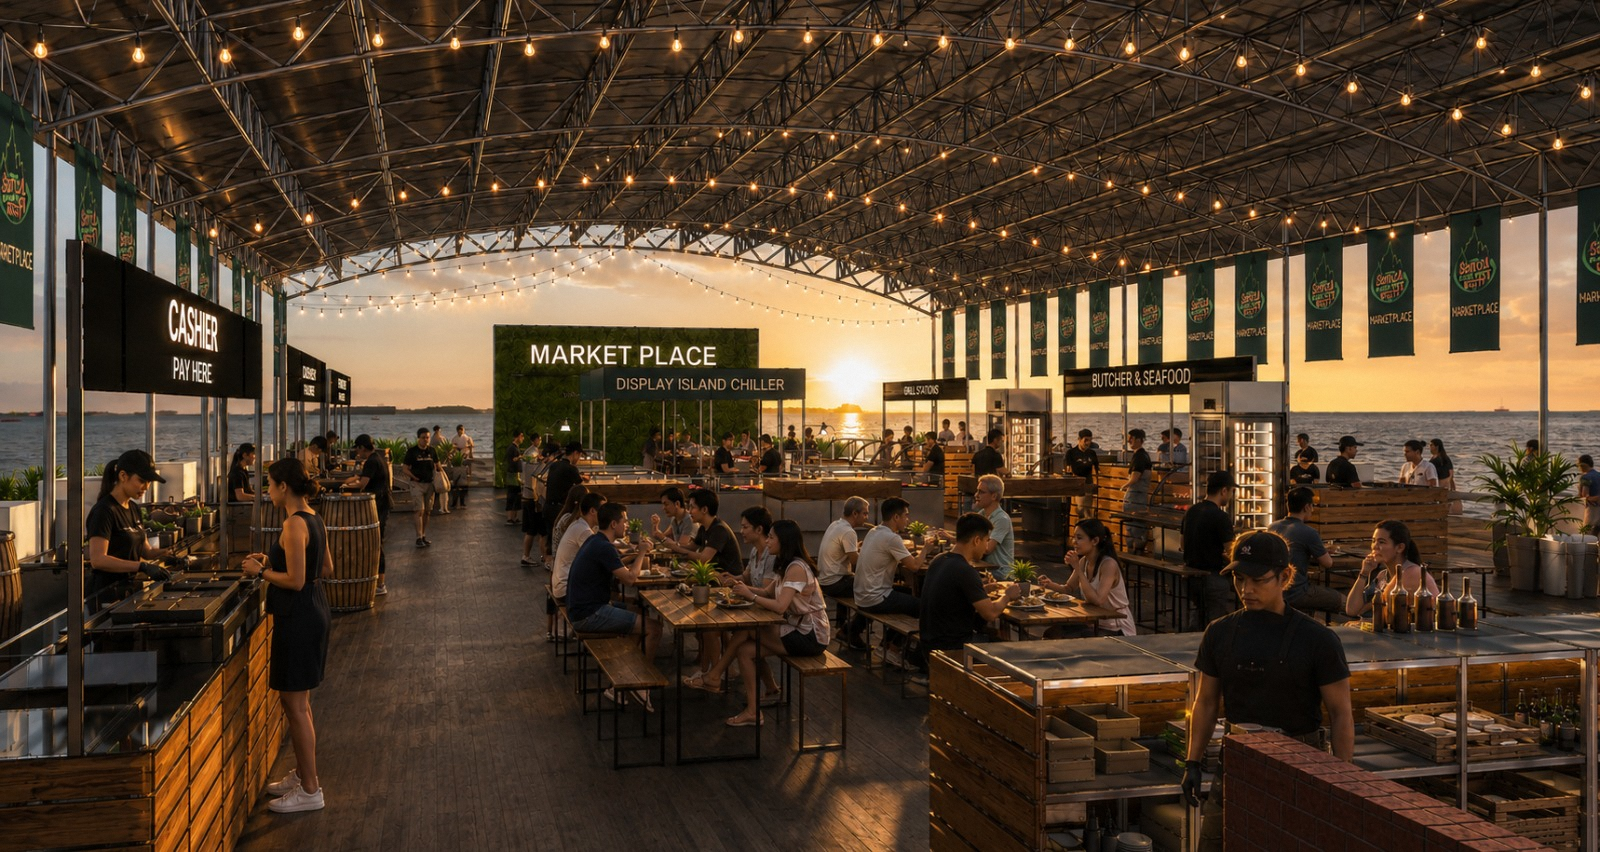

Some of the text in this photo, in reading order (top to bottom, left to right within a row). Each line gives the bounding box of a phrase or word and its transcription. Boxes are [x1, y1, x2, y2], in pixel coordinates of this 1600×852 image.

[168, 299, 219, 353] CASHIER
[530, 344, 718, 367] MARKET PLACE
[173, 356, 213, 384] PAY HERE
[1092, 367, 1191, 388] BUTCHER & SEAFOOD
[616, 377, 785, 391] DISPLAY ISLAND CHILLER
